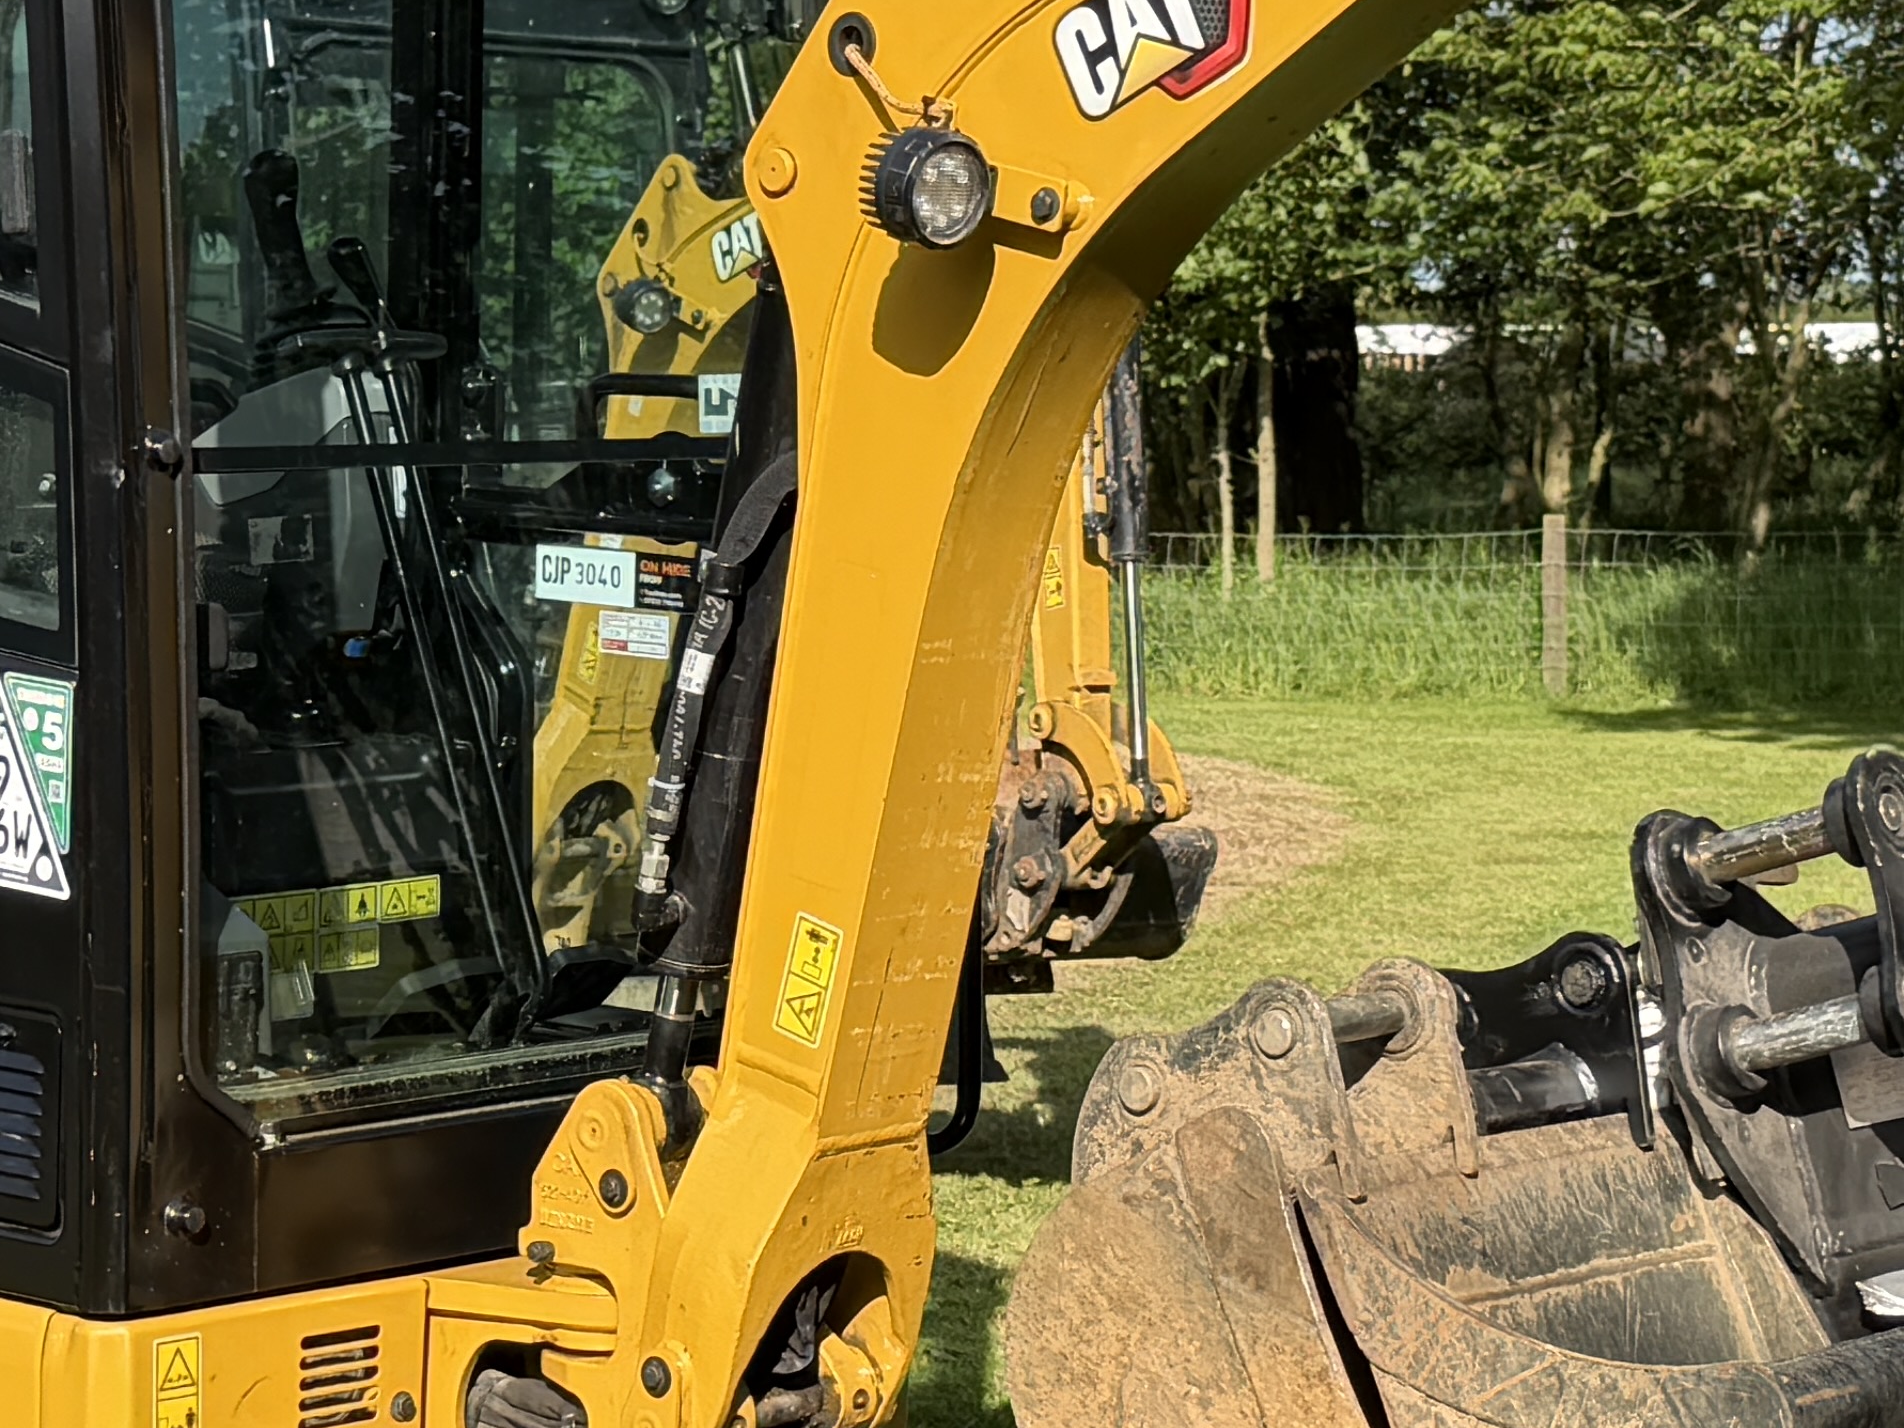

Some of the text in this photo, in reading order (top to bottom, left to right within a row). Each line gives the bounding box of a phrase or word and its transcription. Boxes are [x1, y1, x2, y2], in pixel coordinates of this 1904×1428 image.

[711, 211, 763, 282] CAT
[542, 554, 622, 589] CJP 3040
[41, 710, 64, 751] 5
